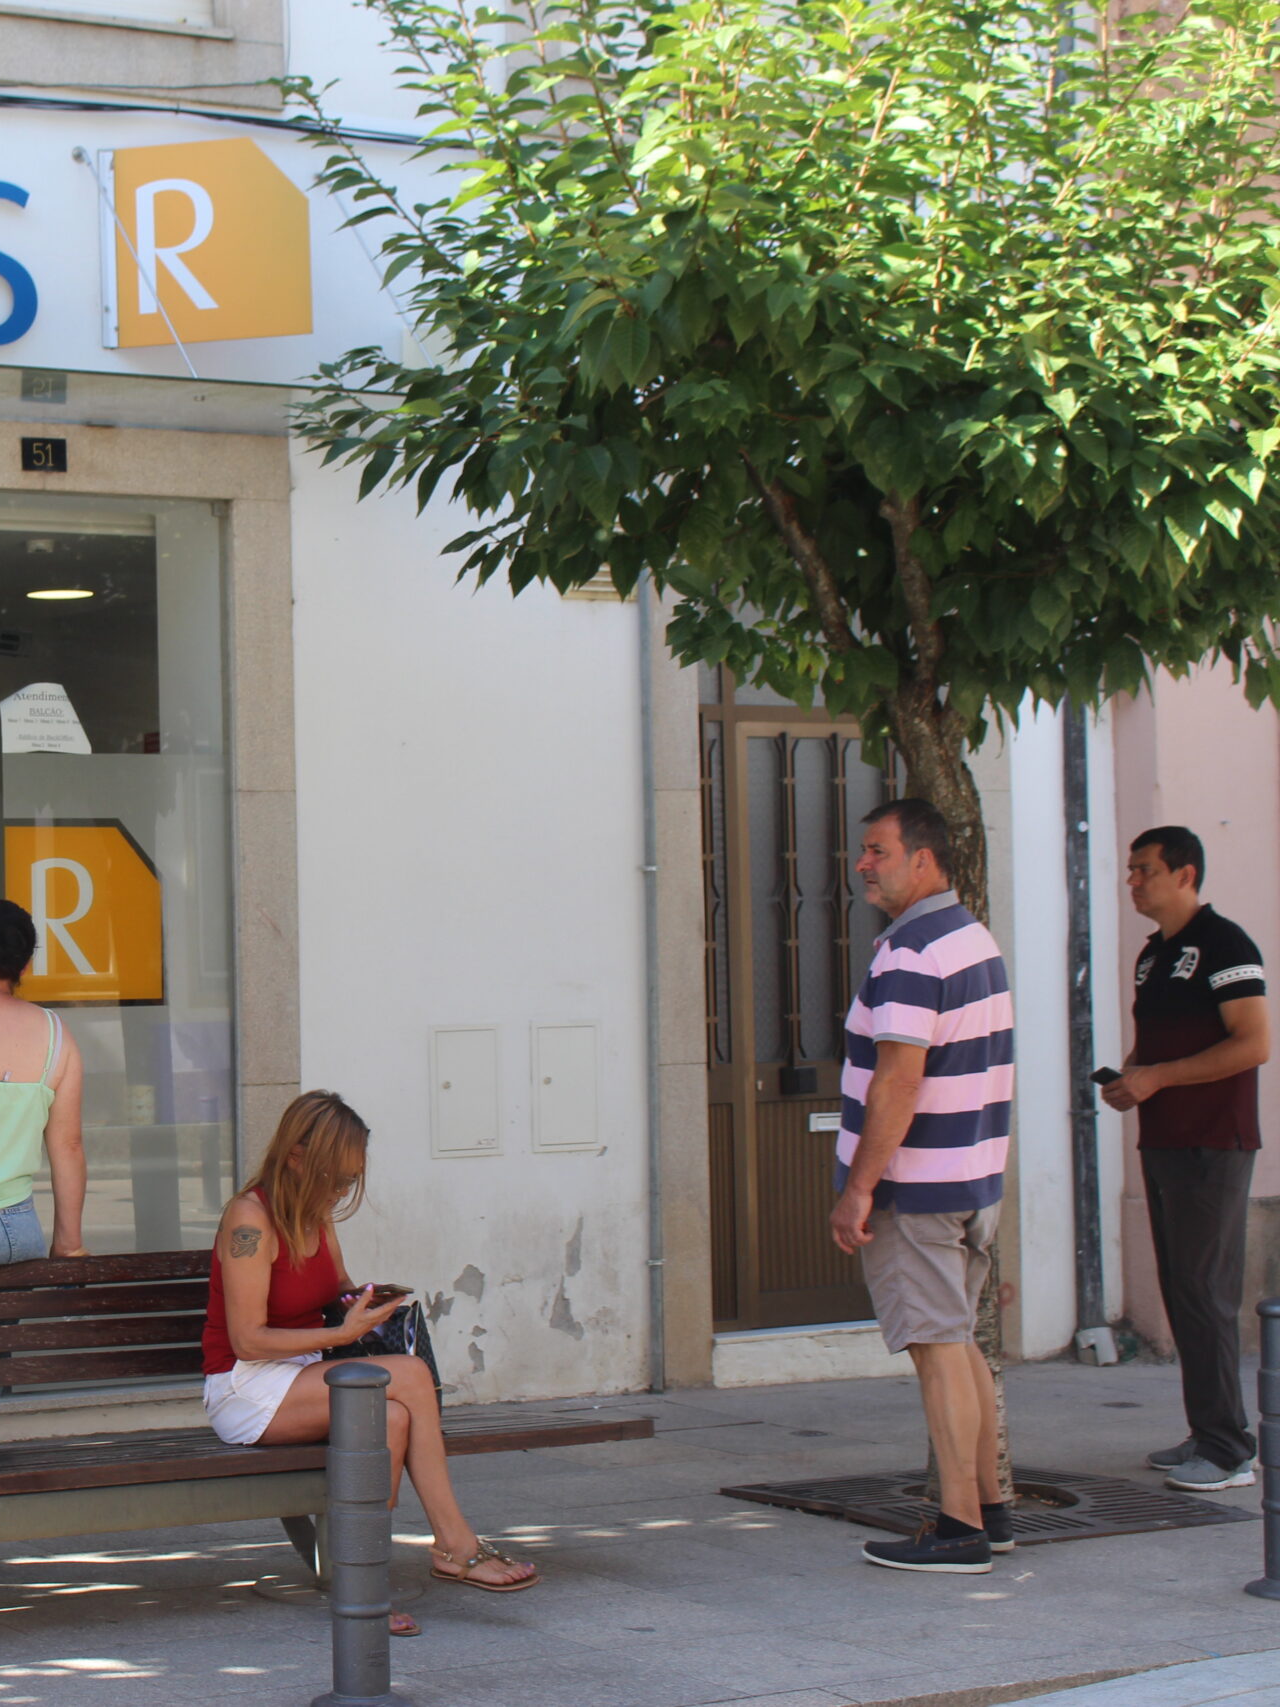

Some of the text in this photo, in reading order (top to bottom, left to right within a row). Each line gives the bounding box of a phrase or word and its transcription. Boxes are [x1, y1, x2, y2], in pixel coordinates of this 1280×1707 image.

[134, 176, 220, 315] R
[32, 442, 54, 467] 51
[31, 857, 97, 976] R
